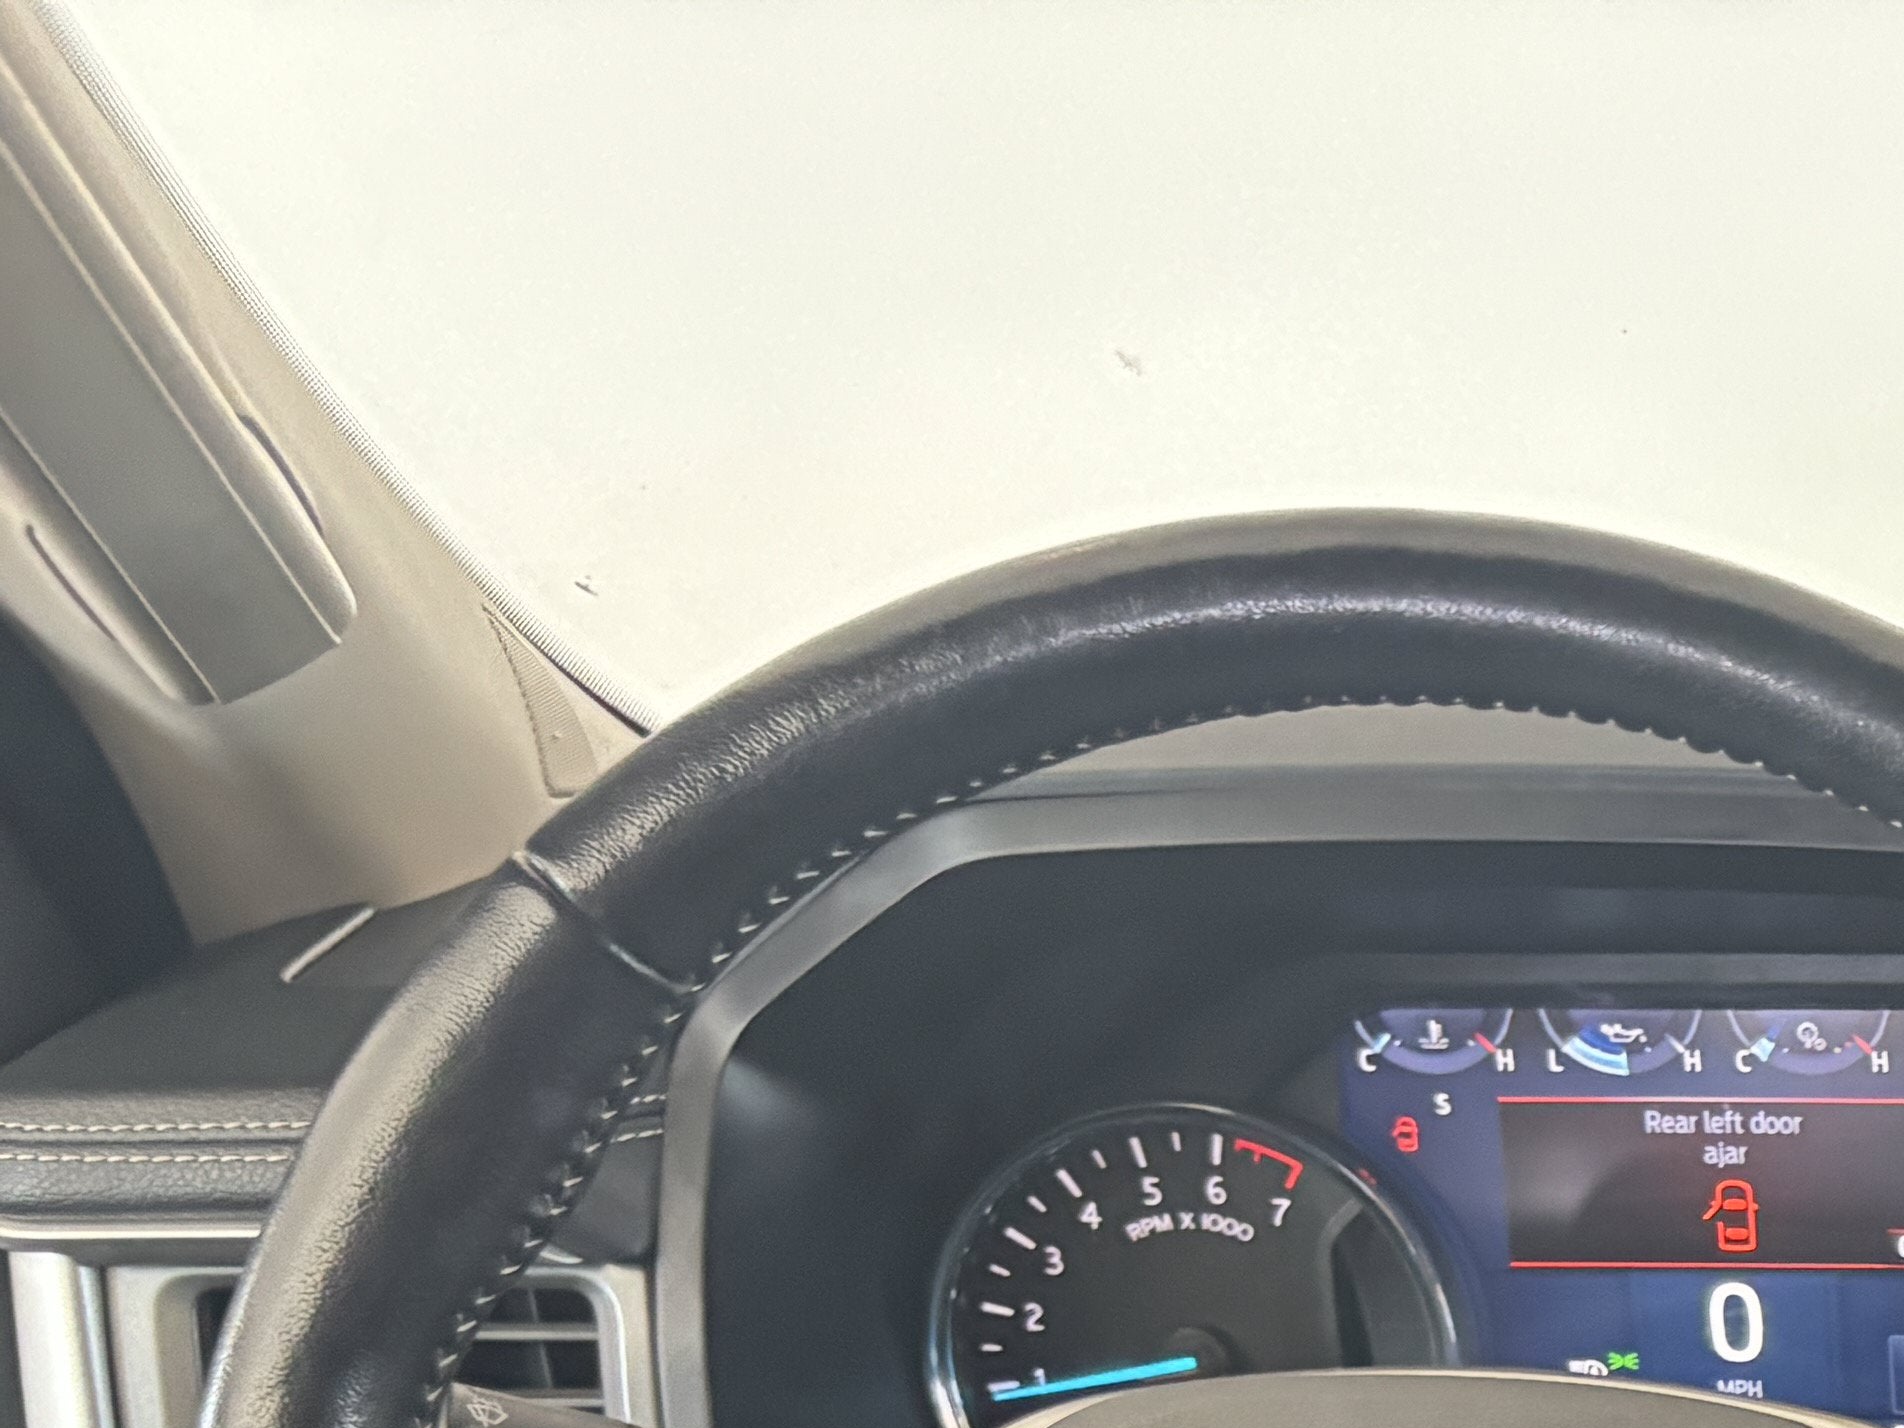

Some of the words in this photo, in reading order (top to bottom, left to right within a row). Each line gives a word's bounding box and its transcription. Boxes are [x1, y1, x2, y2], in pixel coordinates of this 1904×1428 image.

[1358, 1050, 1377, 1073] C
[1495, 1050, 1515, 1072] H
[1548, 1050, 1564, 1072] L
[1684, 1050, 1702, 1073] H
[1735, 1051, 1752, 1074] C
[1872, 1051, 1889, 1074] H
[1434, 1094, 1452, 1116] S
[1644, 1110, 1697, 1135] Rear
[1704, 1110, 1744, 1135] left
[1750, 1110, 1803, 1135] door
[1703, 1143, 1748, 1168] ajar
[1142, 1177, 1163, 1207] 5
[1206, 1175, 1227, 1205] 6
[1080, 1202, 1103, 1230] 4
[1269, 1197, 1293, 1227] 7
[1125, 1213, 1174, 1243] RPM
[1200, 1212, 1255, 1242] 1000
[1045, 1246, 1065, 1276] 3
[1025, 1302, 1046, 1333] 2
[1707, 1281, 1765, 1363] 0
[1717, 1380, 1763, 1399] MPH
